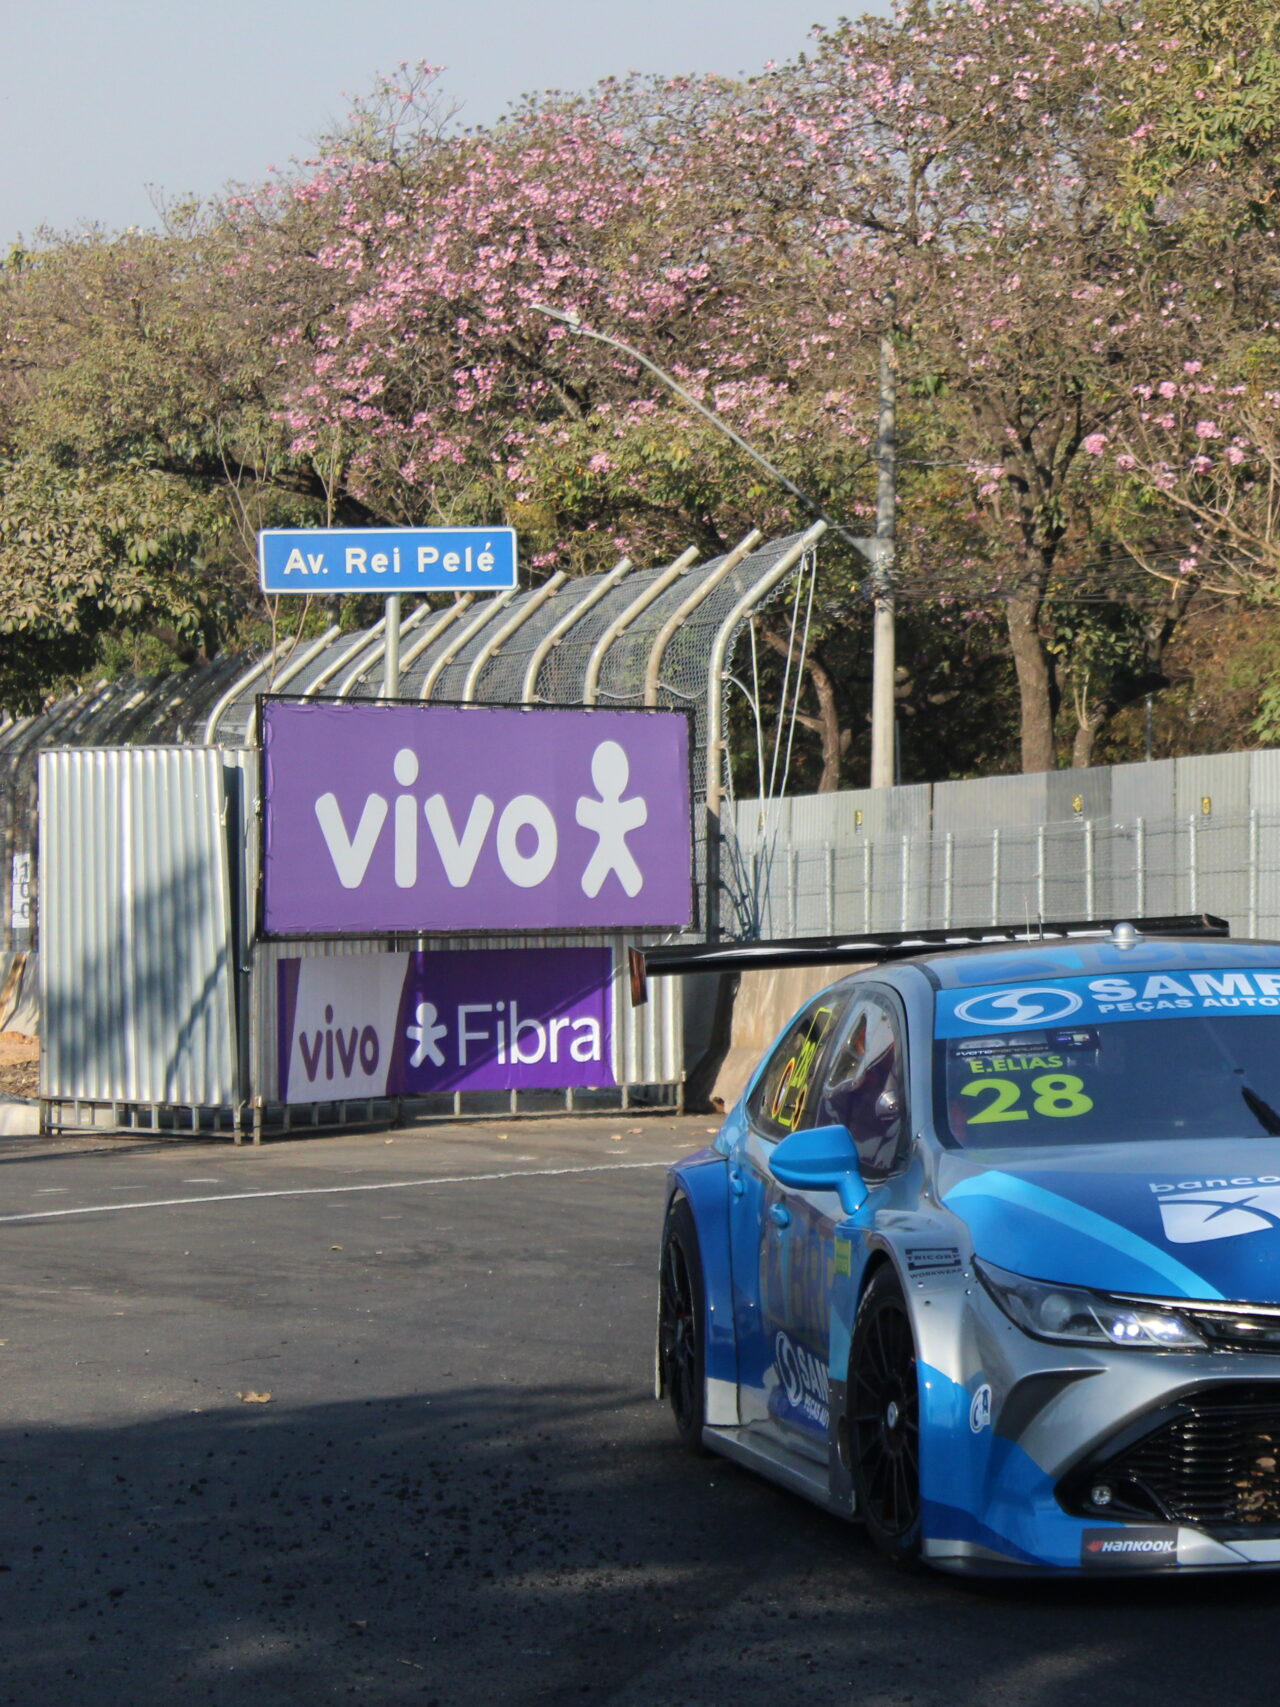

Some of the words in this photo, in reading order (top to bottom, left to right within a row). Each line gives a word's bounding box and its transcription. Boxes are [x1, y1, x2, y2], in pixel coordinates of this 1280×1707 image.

[283, 548, 328, 574] Av.
[345, 547, 401, 574] Rei
[417, 541, 494, 573] Pelé
[315, 748, 558, 889] vivo
[1100, 999, 1193, 1014] PEÇAS
[299, 1004, 380, 1082] vivo
[458, 1000, 601, 1066] Fibra
[970, 1055, 1064, 1073] E.ELIAS
[960, 1074, 1093, 1124] 28
